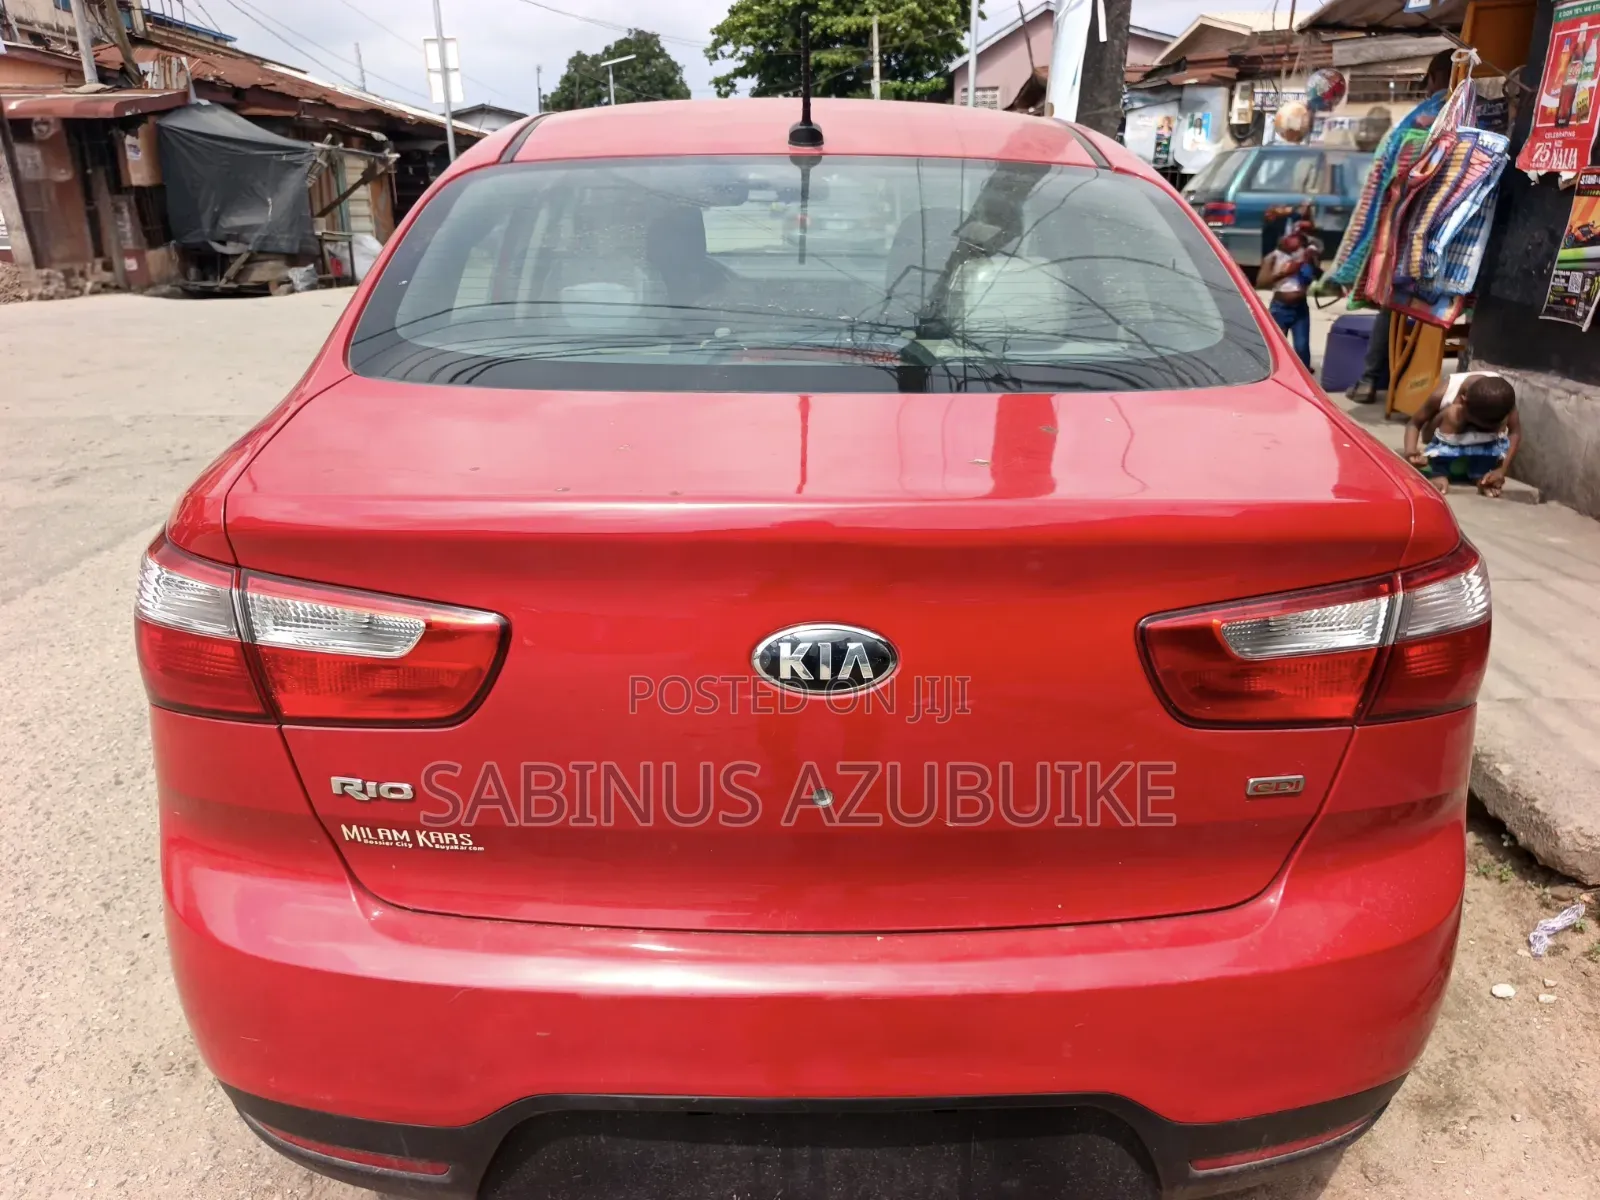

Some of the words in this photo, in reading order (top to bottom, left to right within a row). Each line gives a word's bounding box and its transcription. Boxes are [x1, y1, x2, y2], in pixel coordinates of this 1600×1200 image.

[1532, 142, 1551, 162] 75
[778, 642, 874, 680] KIA
[330, 775, 415, 801] RIO
[340, 823, 411, 843] MILAM
[415, 828, 474, 848] KARS
[363, 838, 394, 847] Bossier
[395, 841, 414, 849] City
[434, 843, 485, 851] BuyaKarcom
